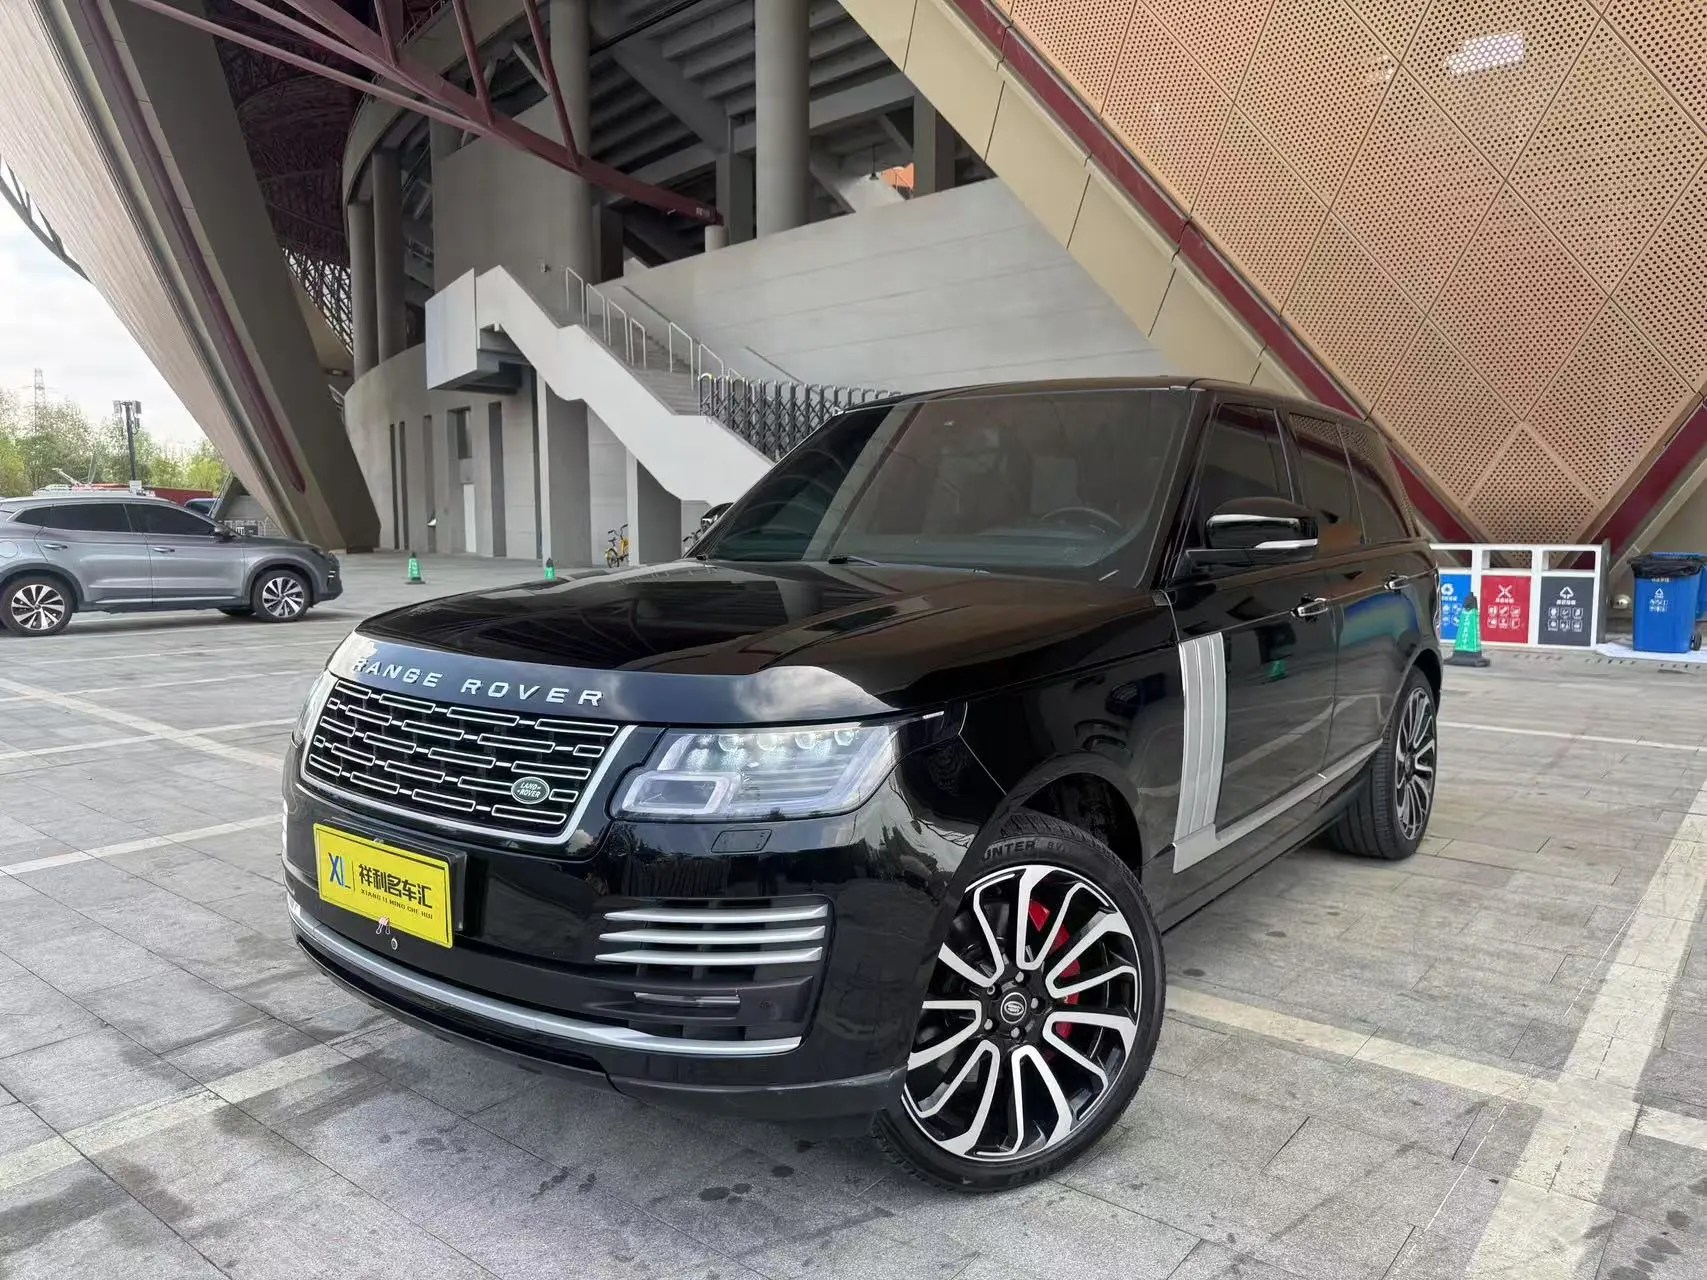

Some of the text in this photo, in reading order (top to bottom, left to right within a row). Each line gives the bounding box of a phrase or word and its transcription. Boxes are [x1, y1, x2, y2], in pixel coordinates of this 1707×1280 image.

[351, 657, 603, 706] RANGE ROVER
[519, 789, 541, 798] ROVER
[520, 782, 538, 790] LAND
[358, 863, 433, 909] 祥利名车汇
[361, 888, 381, 901] XIANG
[389, 899, 406, 910] MING
[406, 904, 418, 914] CHE
